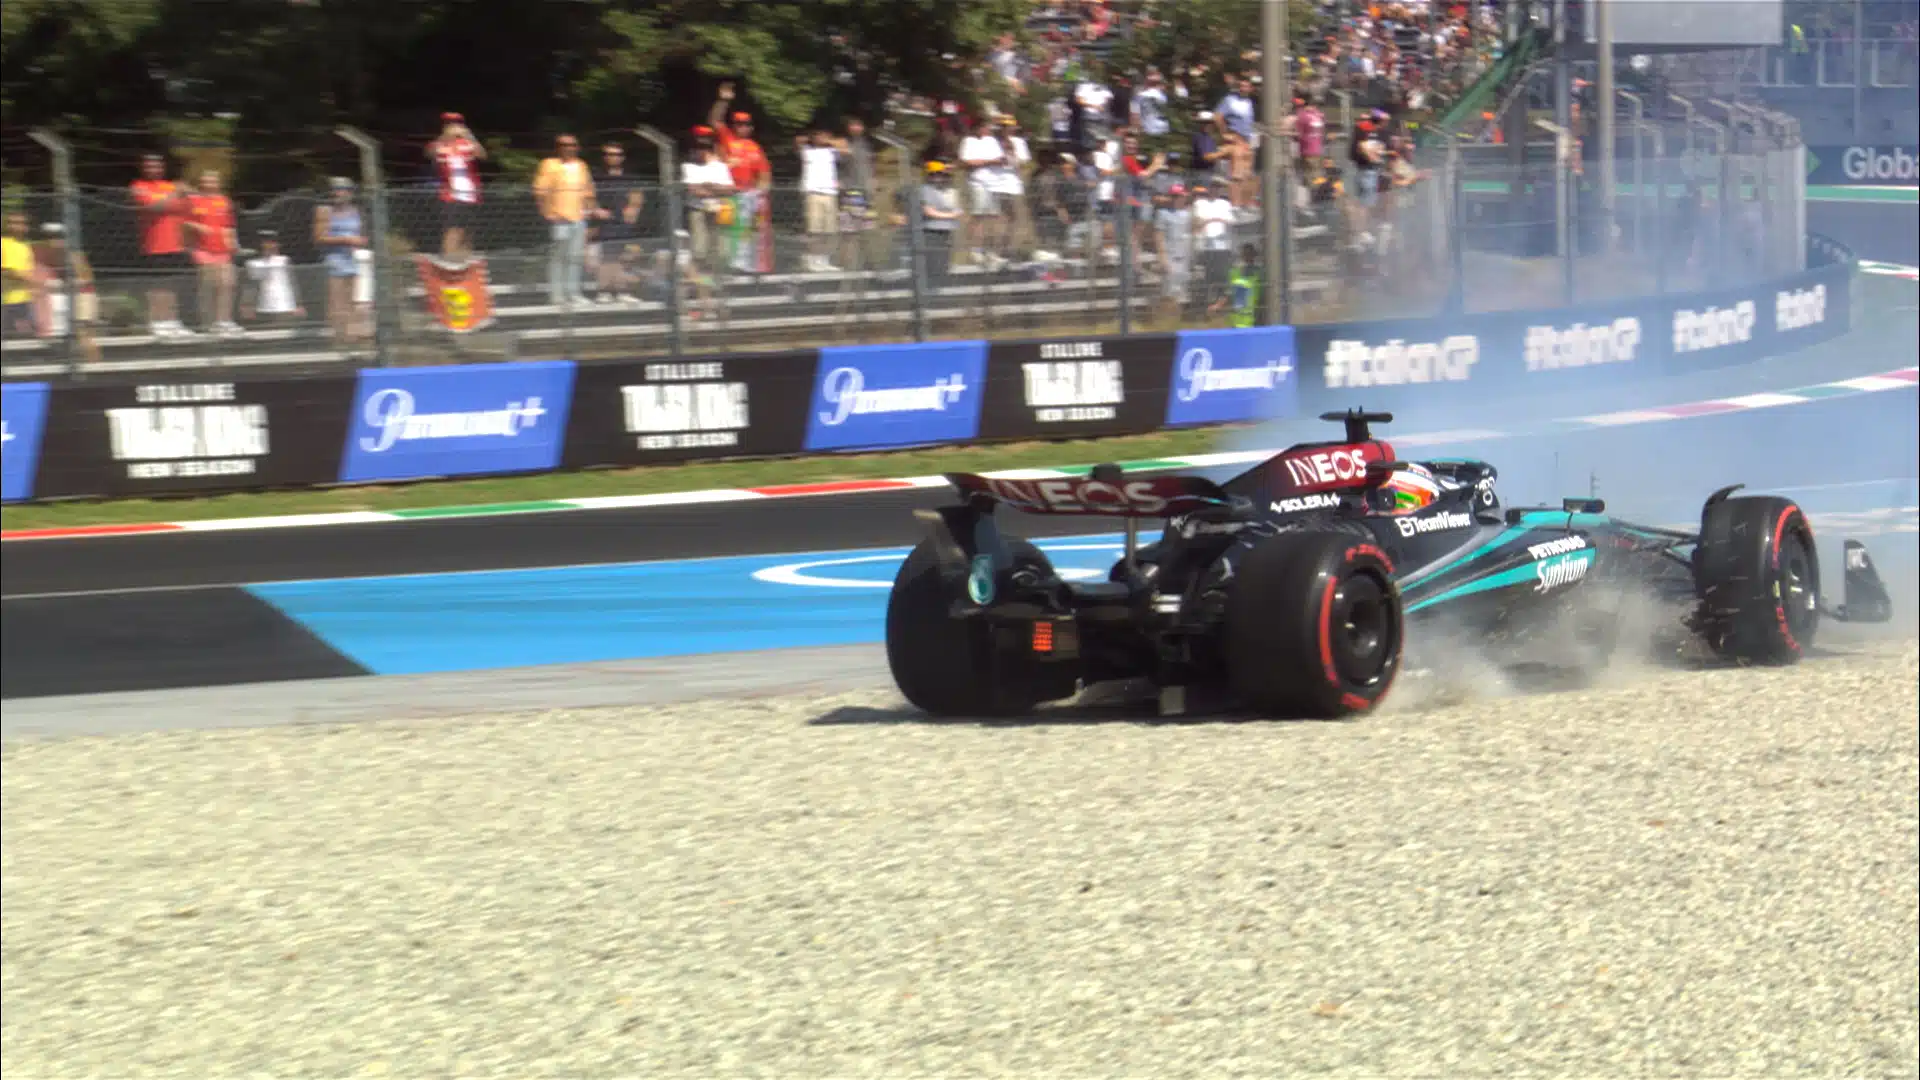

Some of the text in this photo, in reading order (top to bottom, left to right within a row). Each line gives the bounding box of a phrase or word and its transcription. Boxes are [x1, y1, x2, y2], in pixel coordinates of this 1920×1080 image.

[1285, 450, 1367, 487] INEOS
[986, 481, 1168, 513] INEOS
[1411, 511, 1471, 533] TeamViewer
[1527, 535, 1586, 560] PETRONAS
[1533, 553, 1588, 595] Syntium
